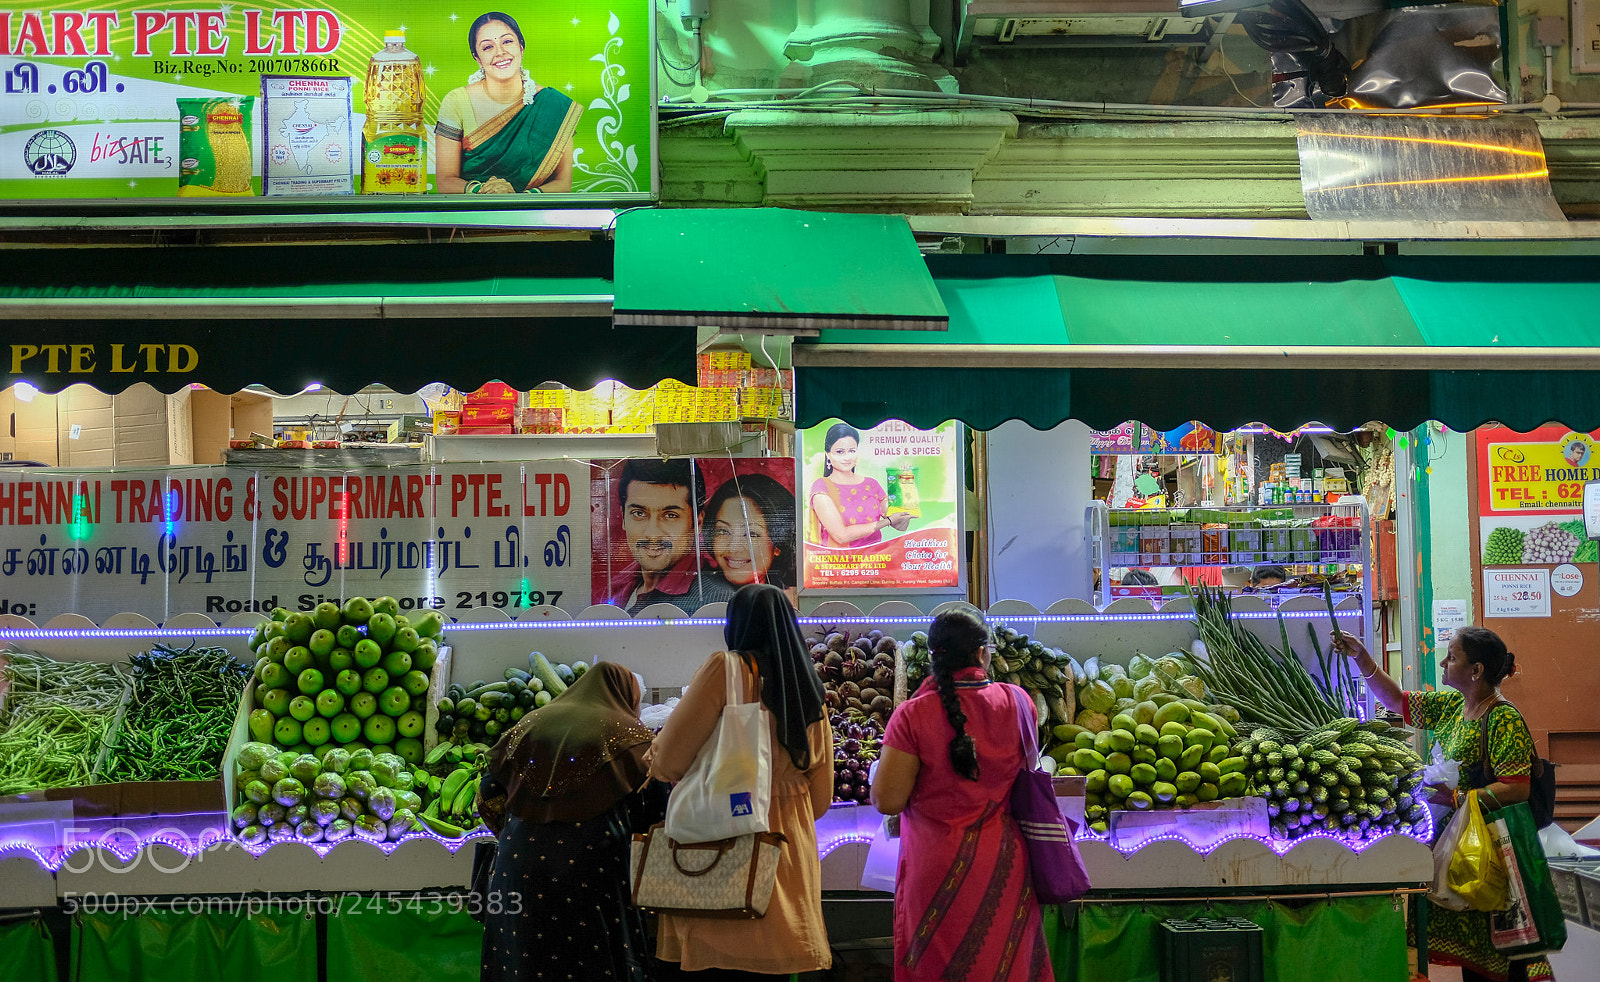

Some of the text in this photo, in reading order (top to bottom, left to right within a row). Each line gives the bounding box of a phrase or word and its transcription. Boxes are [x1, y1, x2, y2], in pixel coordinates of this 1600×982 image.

[0, 10, 342, 56] ART PTE LTD
[154, 59, 340, 77] Biz.Reg.No: 200707866R
[9, 343, 199, 374] PTE LTD
[869, 435, 945, 444] PREMIUM QUALITY
[874, 447, 941, 456] DHALS & SPICES
[1492, 465, 1541, 482] FREE
[1545, 468, 1588, 481] HOME
[1496, 488, 1535, 500] TEL
[1558, 482, 1584, 498] 62
[111, 477, 233, 524] TRADING
[244, 477, 262, 521] &
[273, 473, 441, 523] SUPERMART
[451, 473, 510, 518] PTE.
[525, 473, 571, 517] LTD
[263, 528, 289, 568] &
[904, 538, 948, 548] Healthiest
[809, 554, 892, 563] CHENNAI TRADING
[905, 550, 948, 561] Choice for
[901, 561, 952, 572] Your Health
[1494, 573, 1538, 581] CHENNAI
